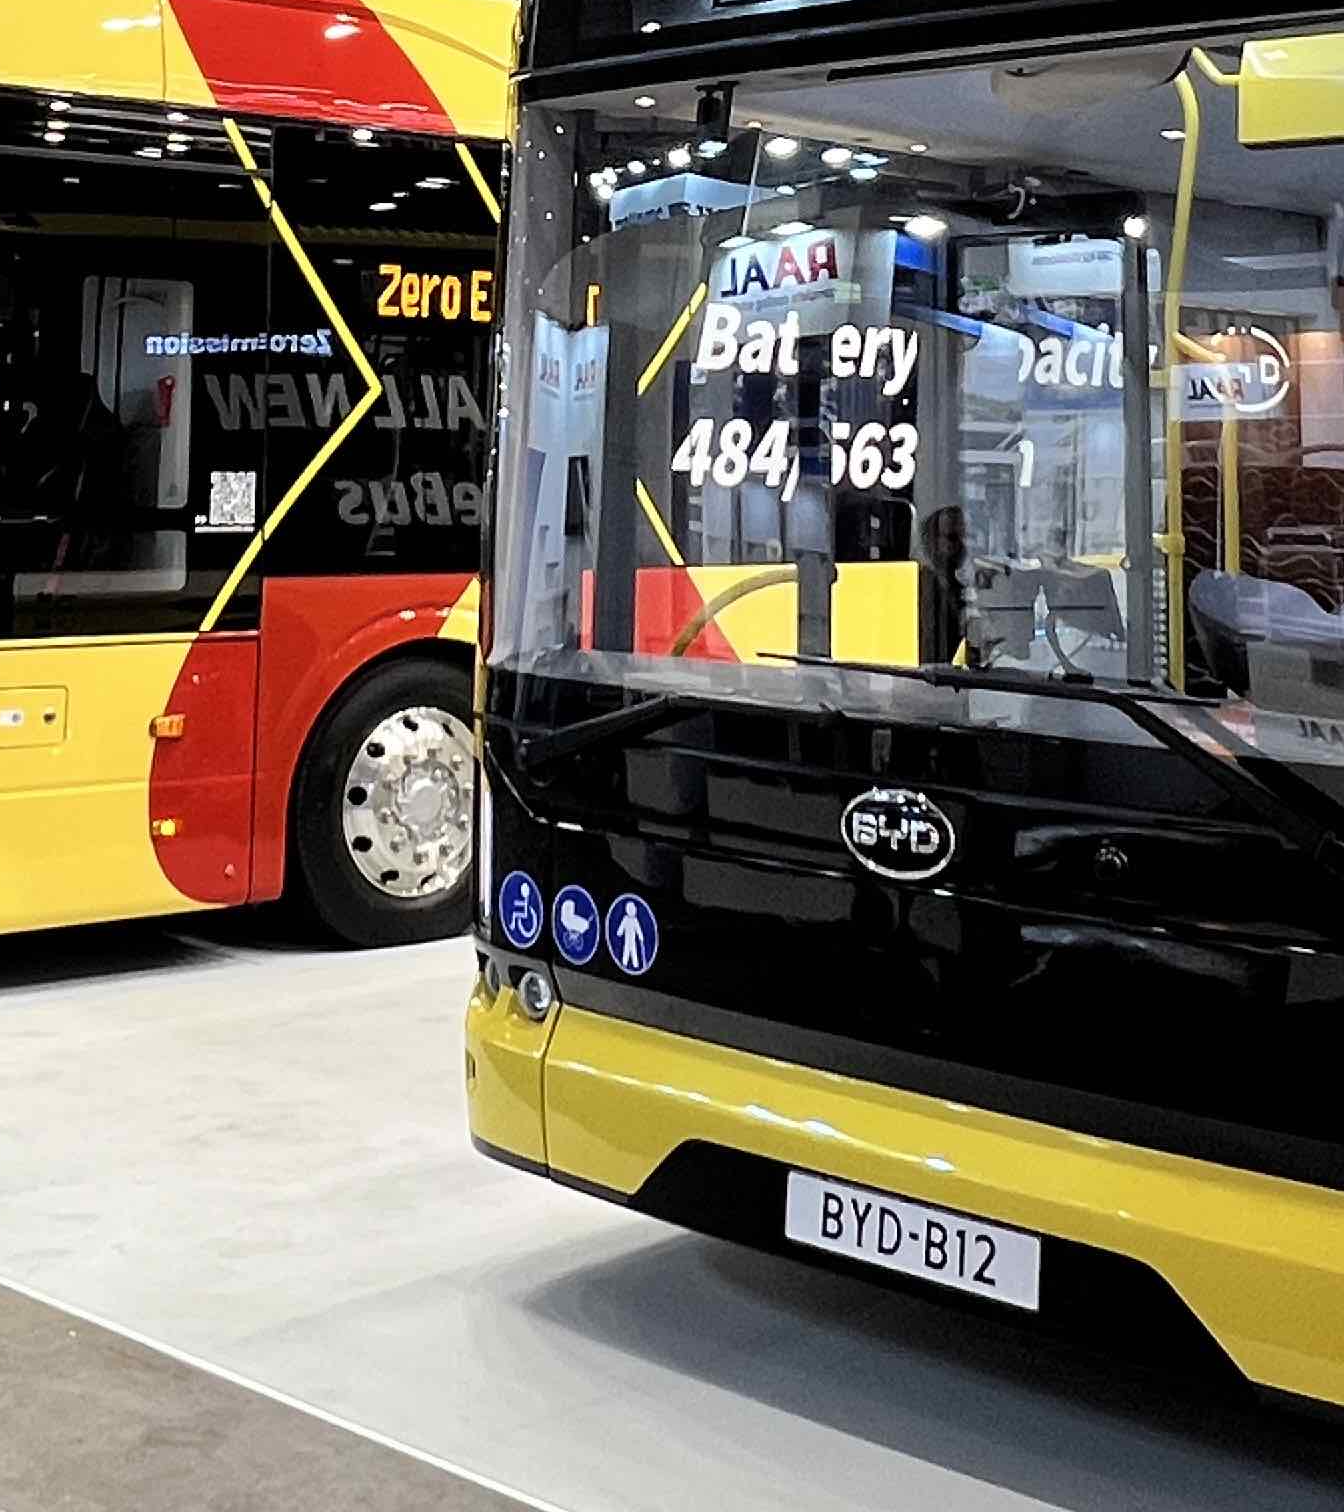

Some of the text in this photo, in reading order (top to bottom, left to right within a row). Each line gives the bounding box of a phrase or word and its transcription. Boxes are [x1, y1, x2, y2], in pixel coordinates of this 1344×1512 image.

[378, 263, 462, 320] Zero
[696, 301, 919, 396] Batery
[852, 810, 940, 854] BYD
[821, 1191, 996, 1286] BYD-B12
